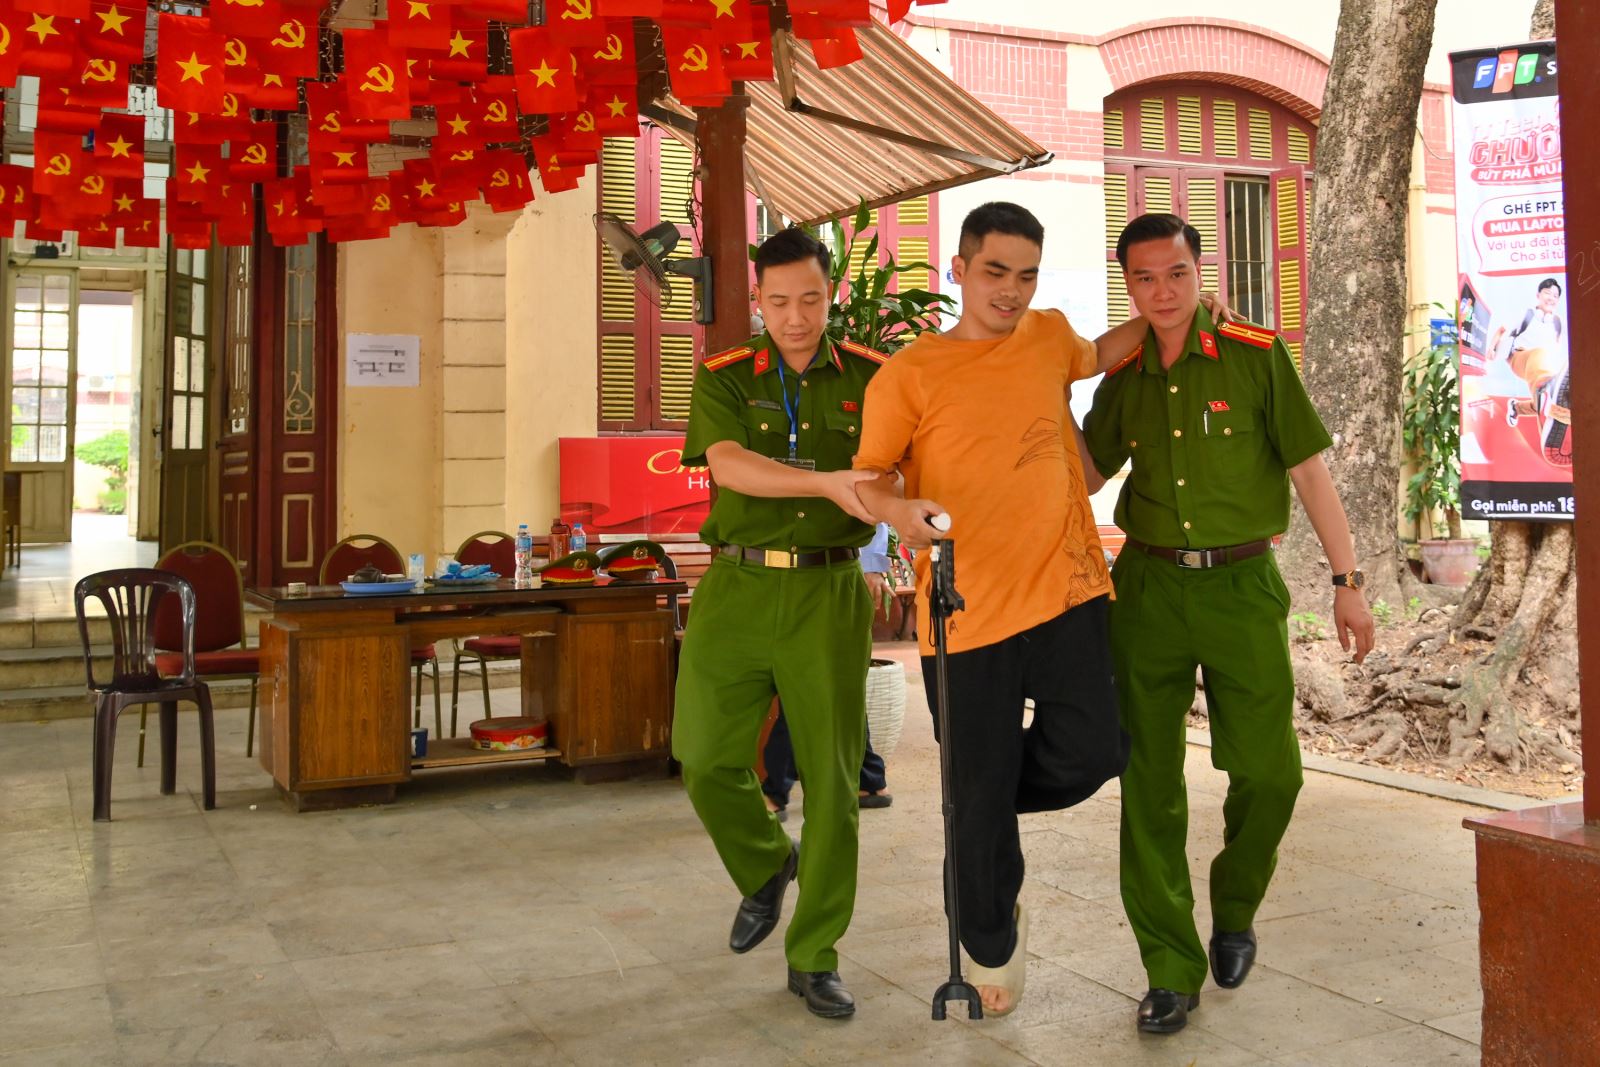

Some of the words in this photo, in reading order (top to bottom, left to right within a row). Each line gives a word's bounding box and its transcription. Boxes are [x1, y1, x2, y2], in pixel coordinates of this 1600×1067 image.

[1475, 57, 1537, 85] FPT
[1503, 200, 1532, 215] GHÉ
[1536, 201, 1557, 212] FPT
[1490, 220, 1521, 234] MUA
[1510, 251, 1536, 262] Cho
[1471, 499, 1494, 513] Gọi
[1496, 498, 1528, 512] miễn
